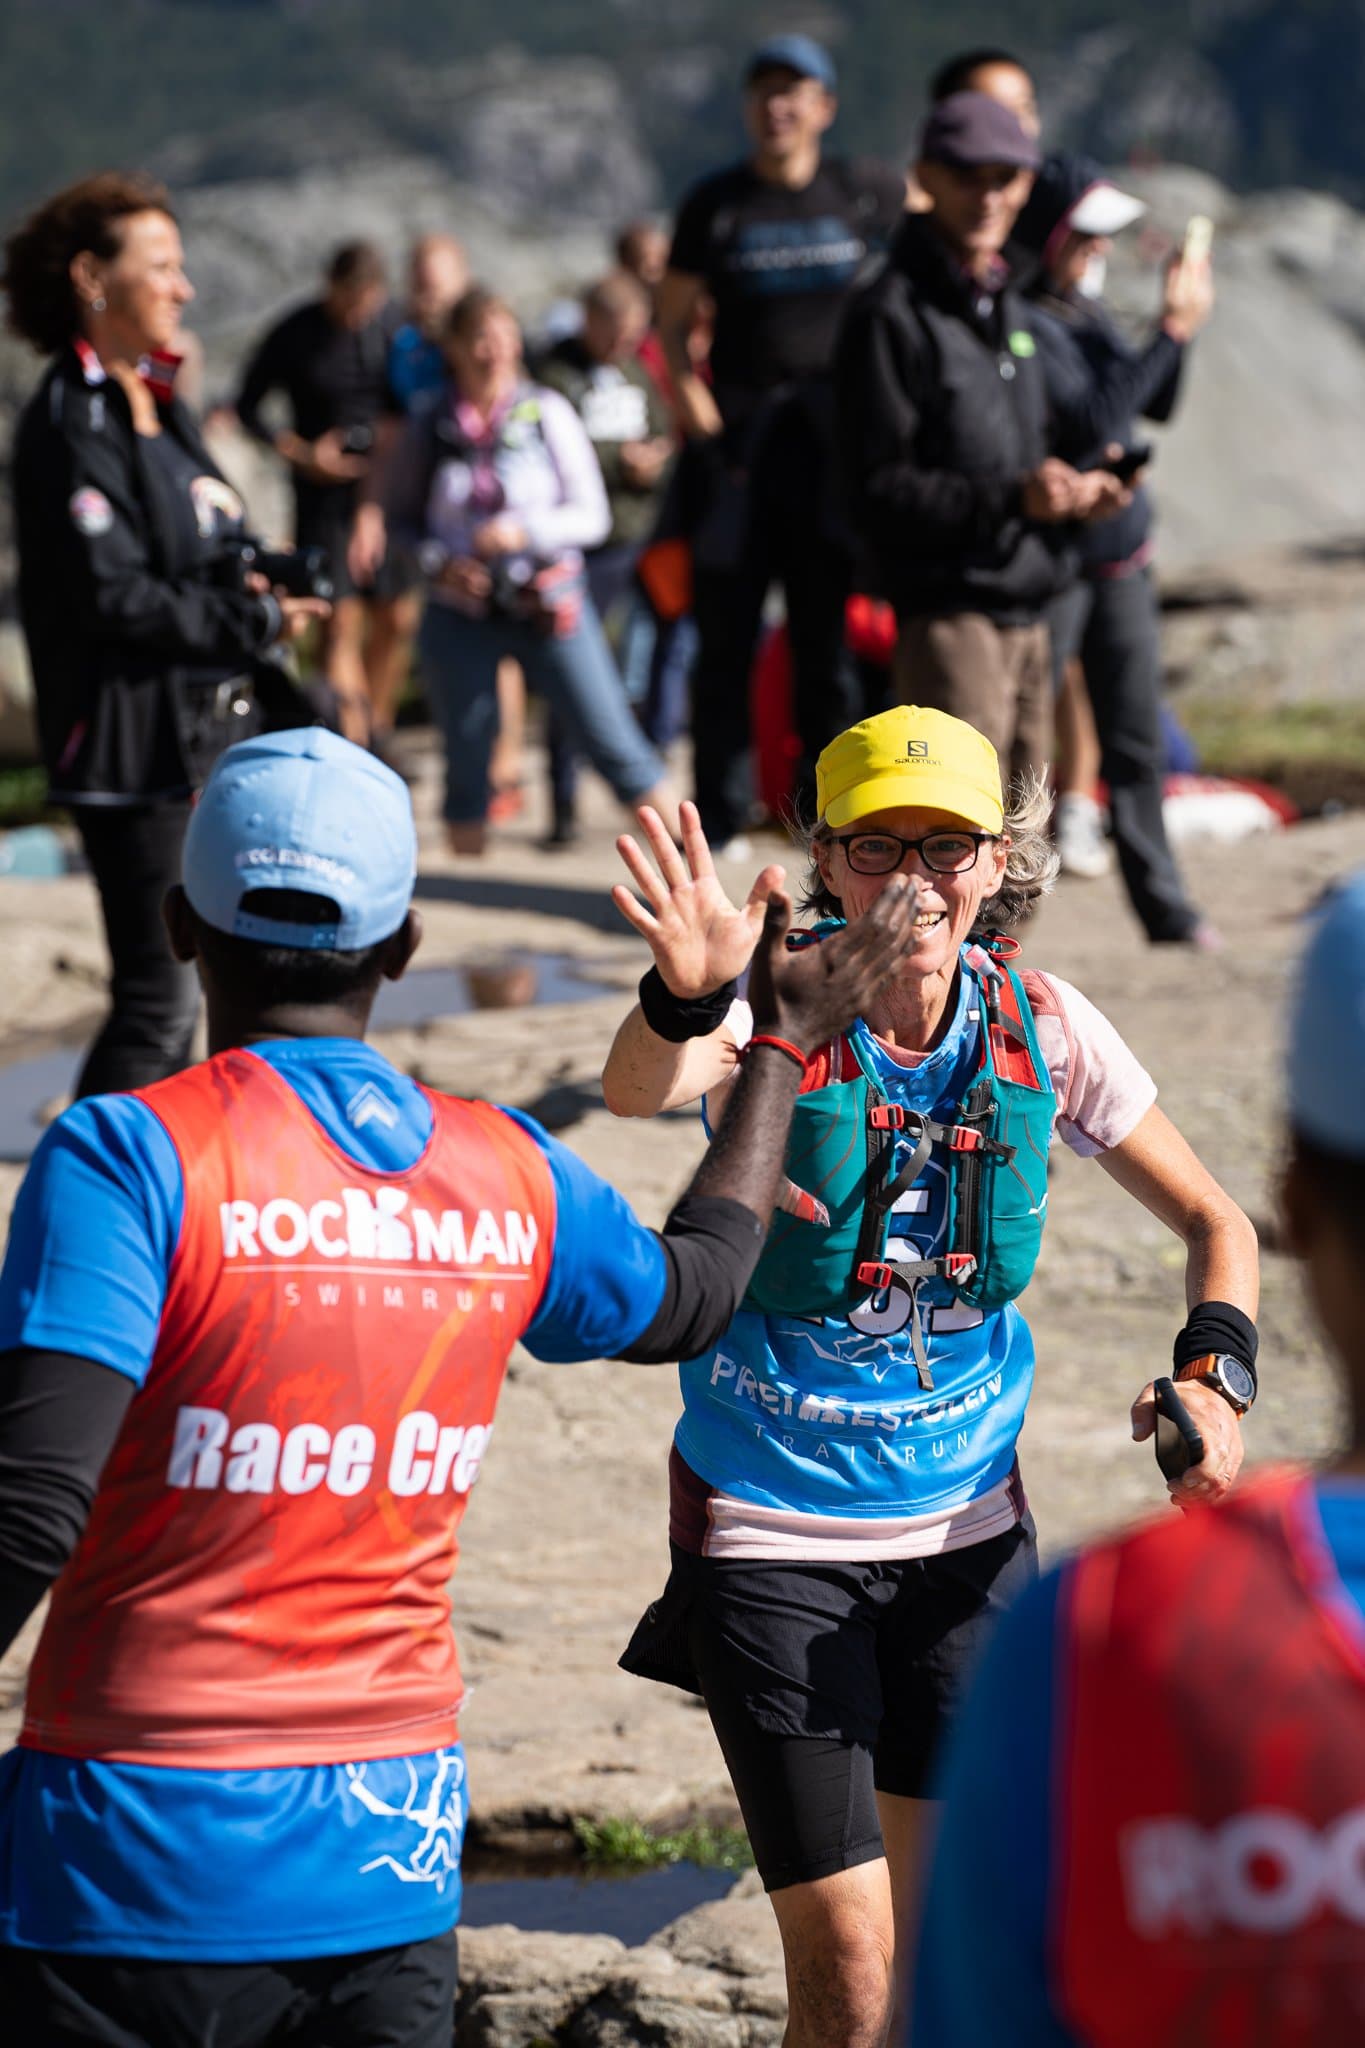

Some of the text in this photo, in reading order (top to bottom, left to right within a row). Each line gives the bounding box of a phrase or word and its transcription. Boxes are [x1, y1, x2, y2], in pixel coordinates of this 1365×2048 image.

[907, 740, 928, 757] S
[283, 1283, 507, 1314] SWIMRUN
[165, 1405, 494, 1498] Race Cre
